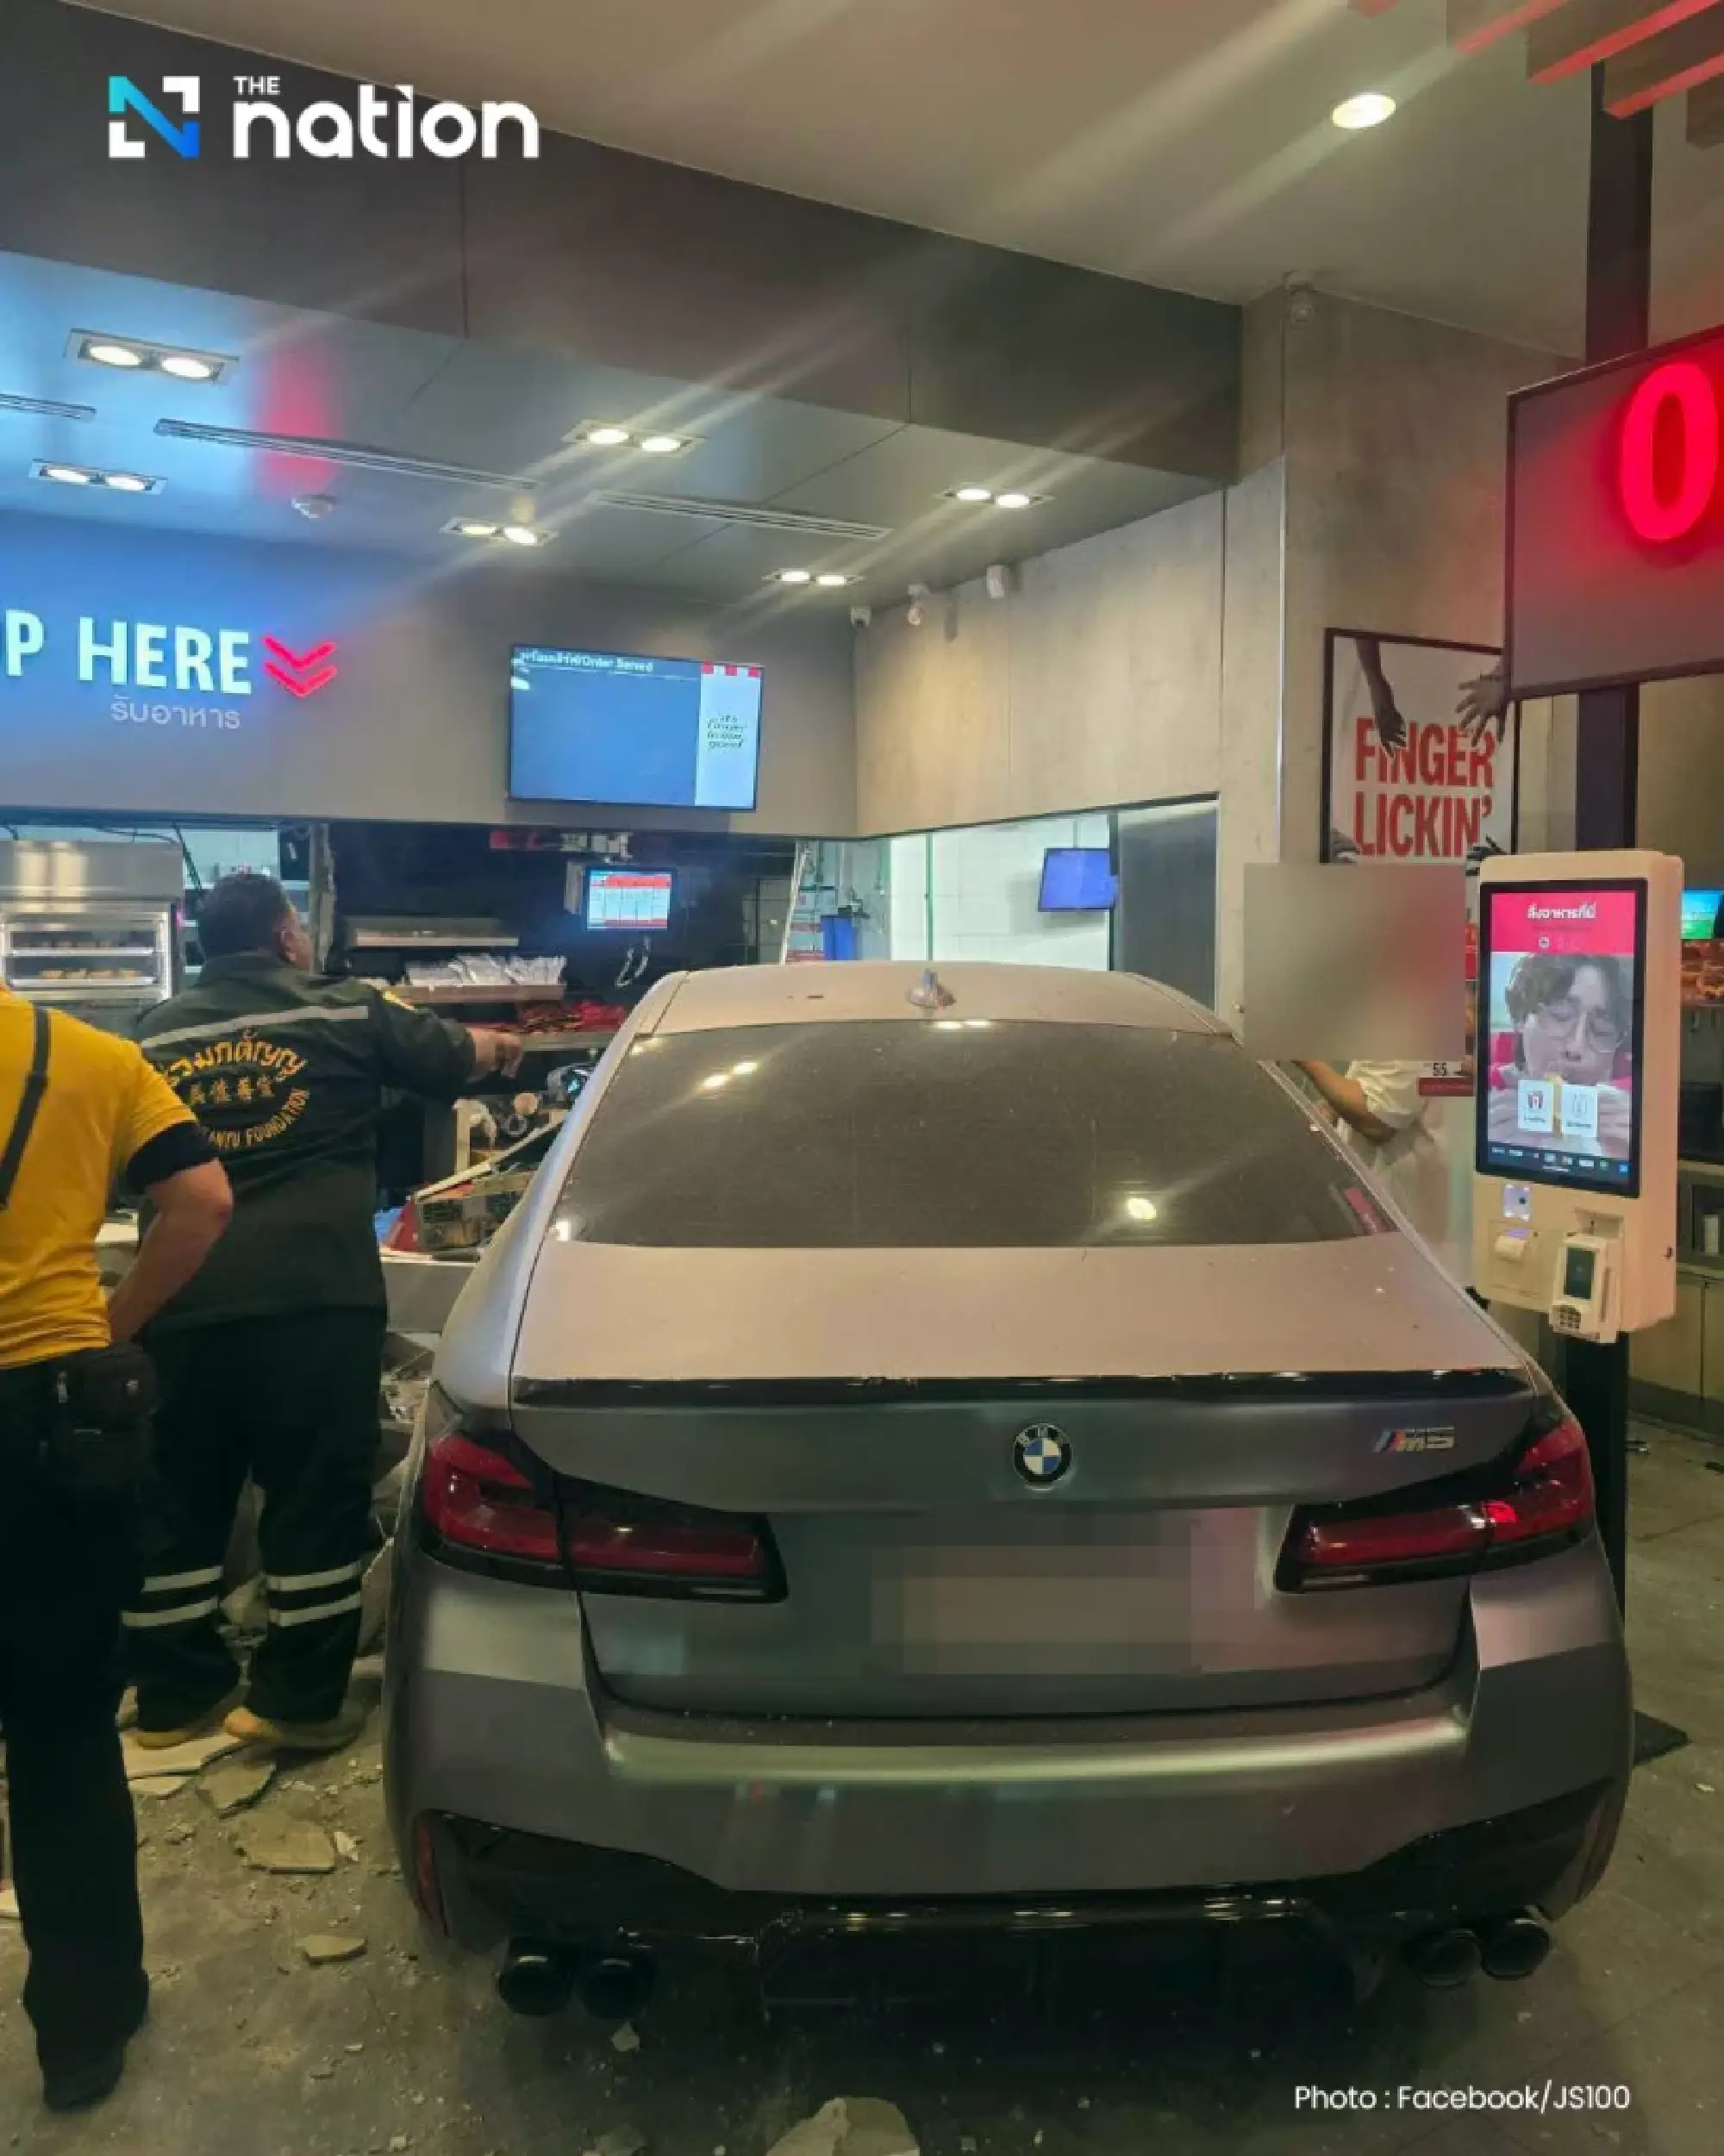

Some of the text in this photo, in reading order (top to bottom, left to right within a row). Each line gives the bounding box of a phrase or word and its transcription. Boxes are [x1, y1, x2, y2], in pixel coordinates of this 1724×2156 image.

[78, 616, 252, 696] HERE
[110, 693, 242, 730] รับอาหาร
[1356, 717, 1496, 789] FINGER
[1354, 791, 1493, 859] LICKIN'
